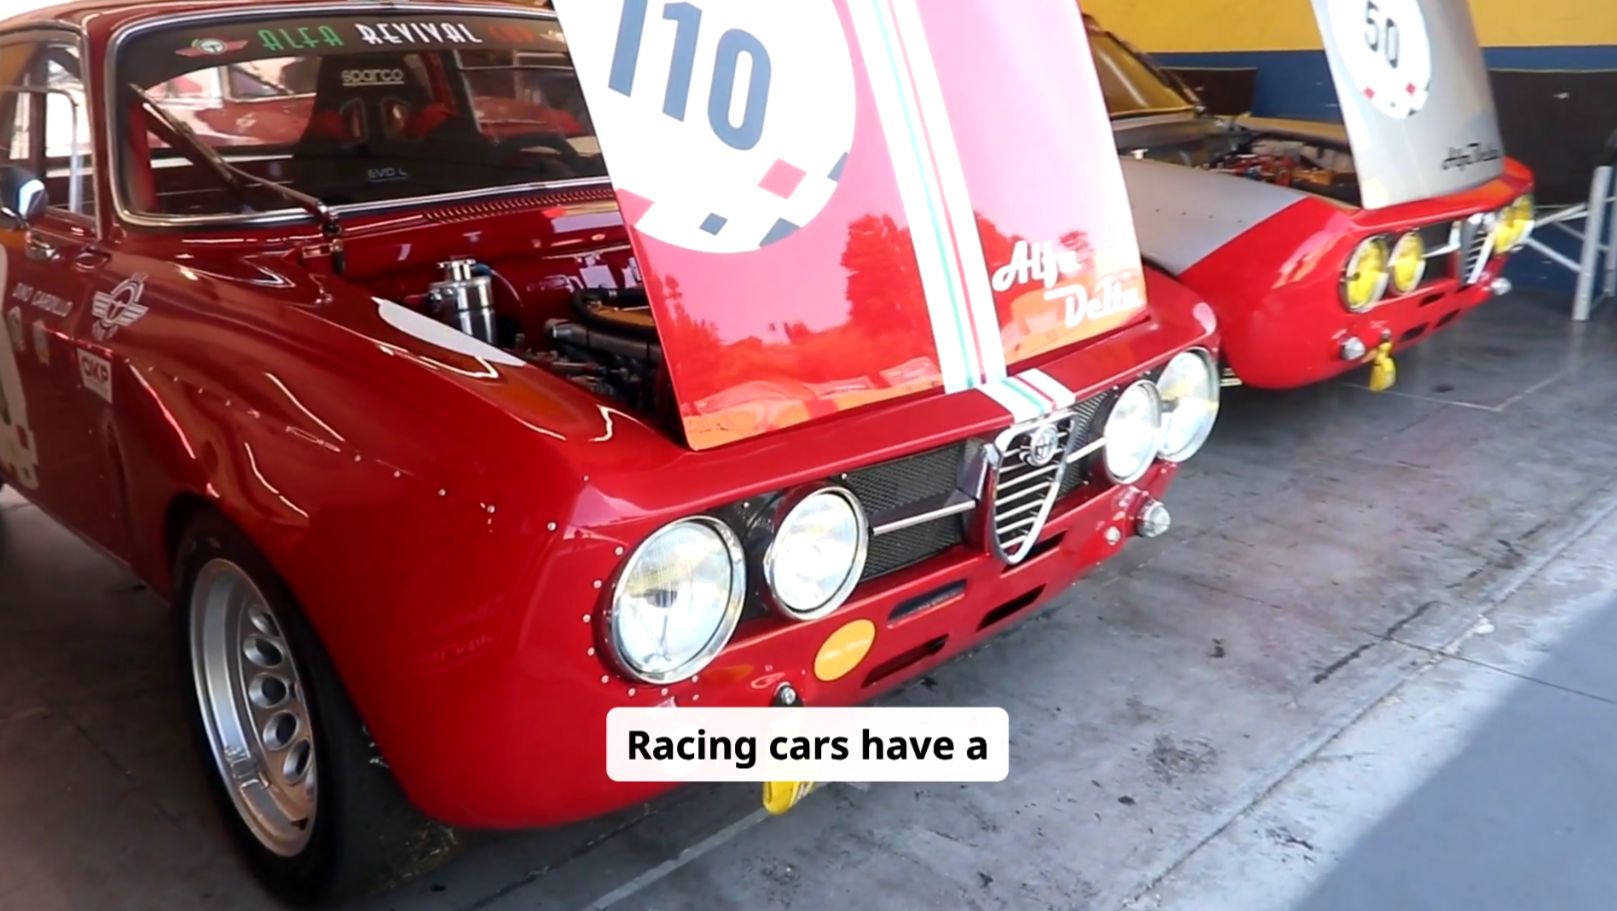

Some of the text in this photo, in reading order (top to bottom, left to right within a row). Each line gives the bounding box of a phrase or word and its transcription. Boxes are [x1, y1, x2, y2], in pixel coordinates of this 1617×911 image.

[258, 26, 344, 50] ALFA
[355, 22, 483, 45] REVIVAL
[1364, 1, 1399, 69] 50
[341, 68, 404, 87] sparco
[607, 0, 772, 151] 110
[991, 239, 1082, 293] Alfa
[1043, 277, 1147, 328] Delta
